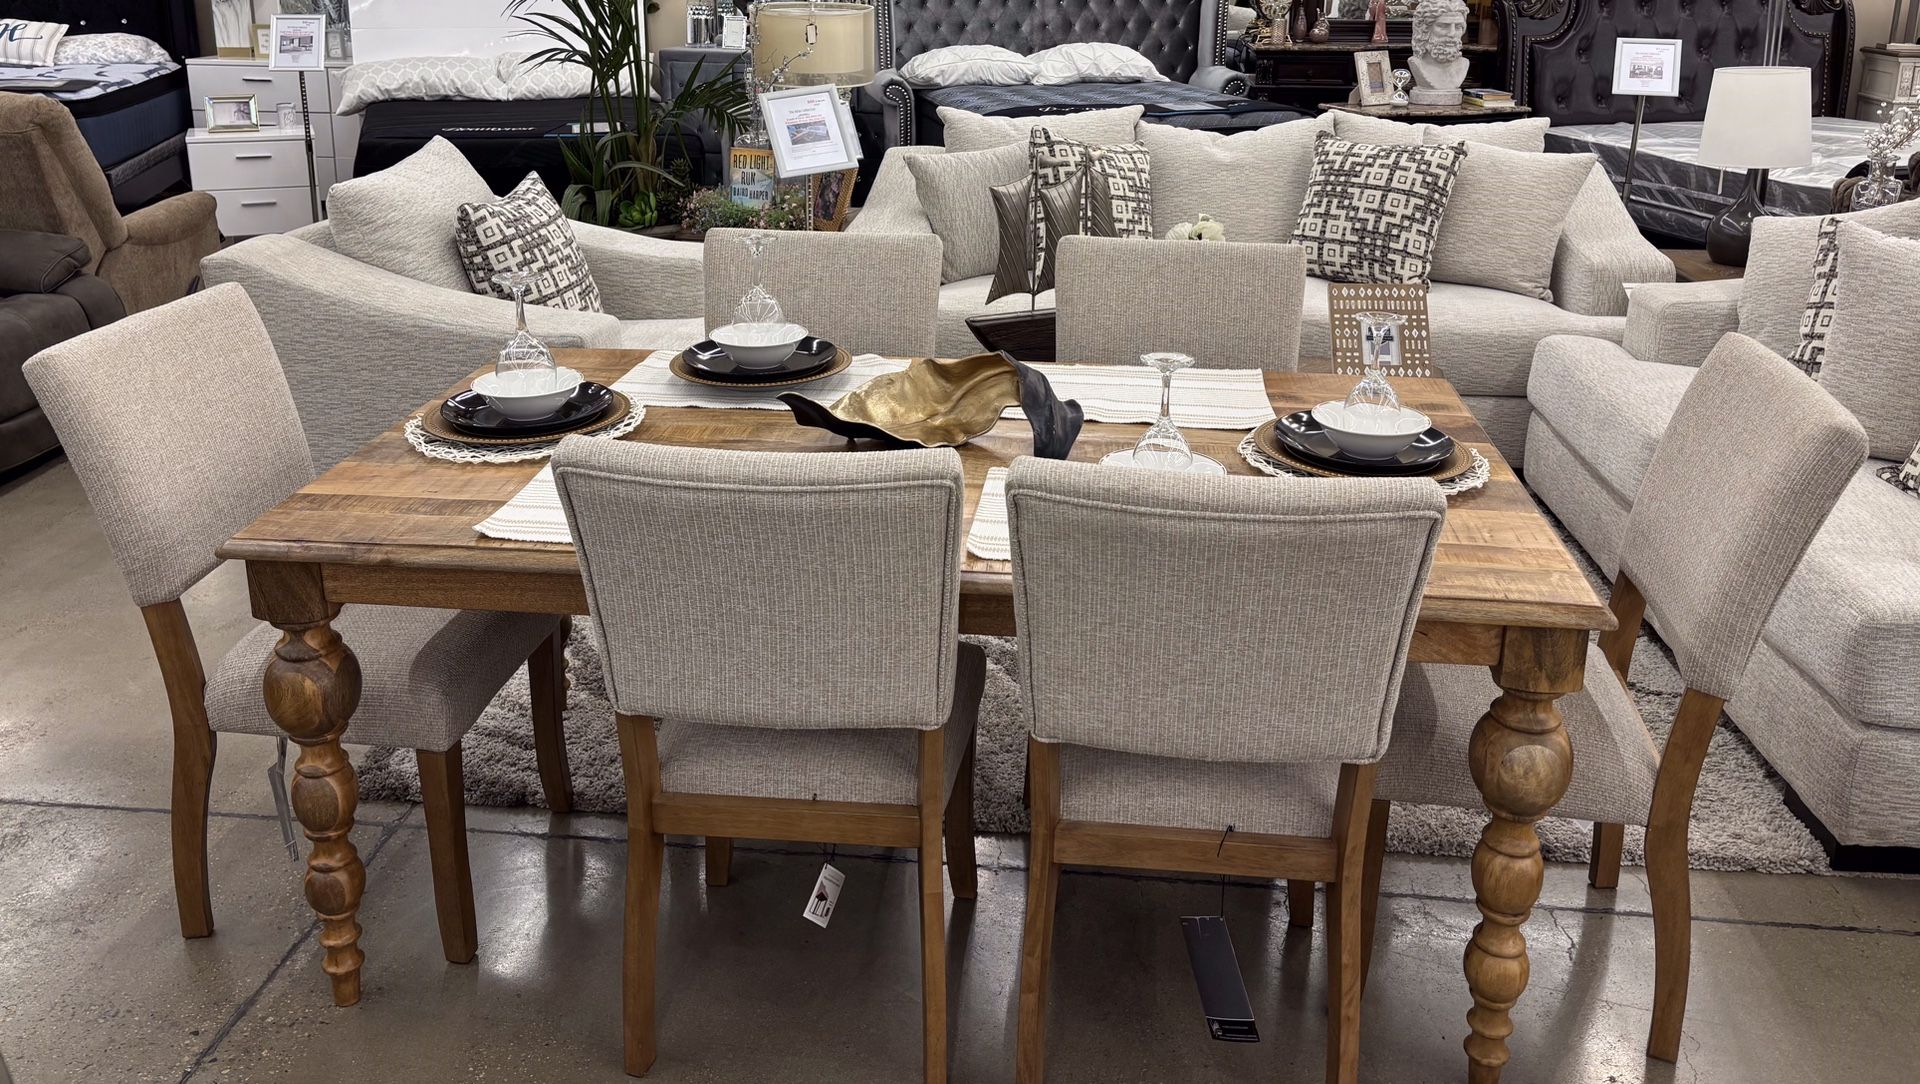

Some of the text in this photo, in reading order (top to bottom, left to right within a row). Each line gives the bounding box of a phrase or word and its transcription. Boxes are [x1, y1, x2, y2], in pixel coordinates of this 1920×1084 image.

[733, 154, 770, 170] RED LIGHT
[741, 171, 756, 186] RUN
[733, 187, 769, 200] BAIRD HARPER
